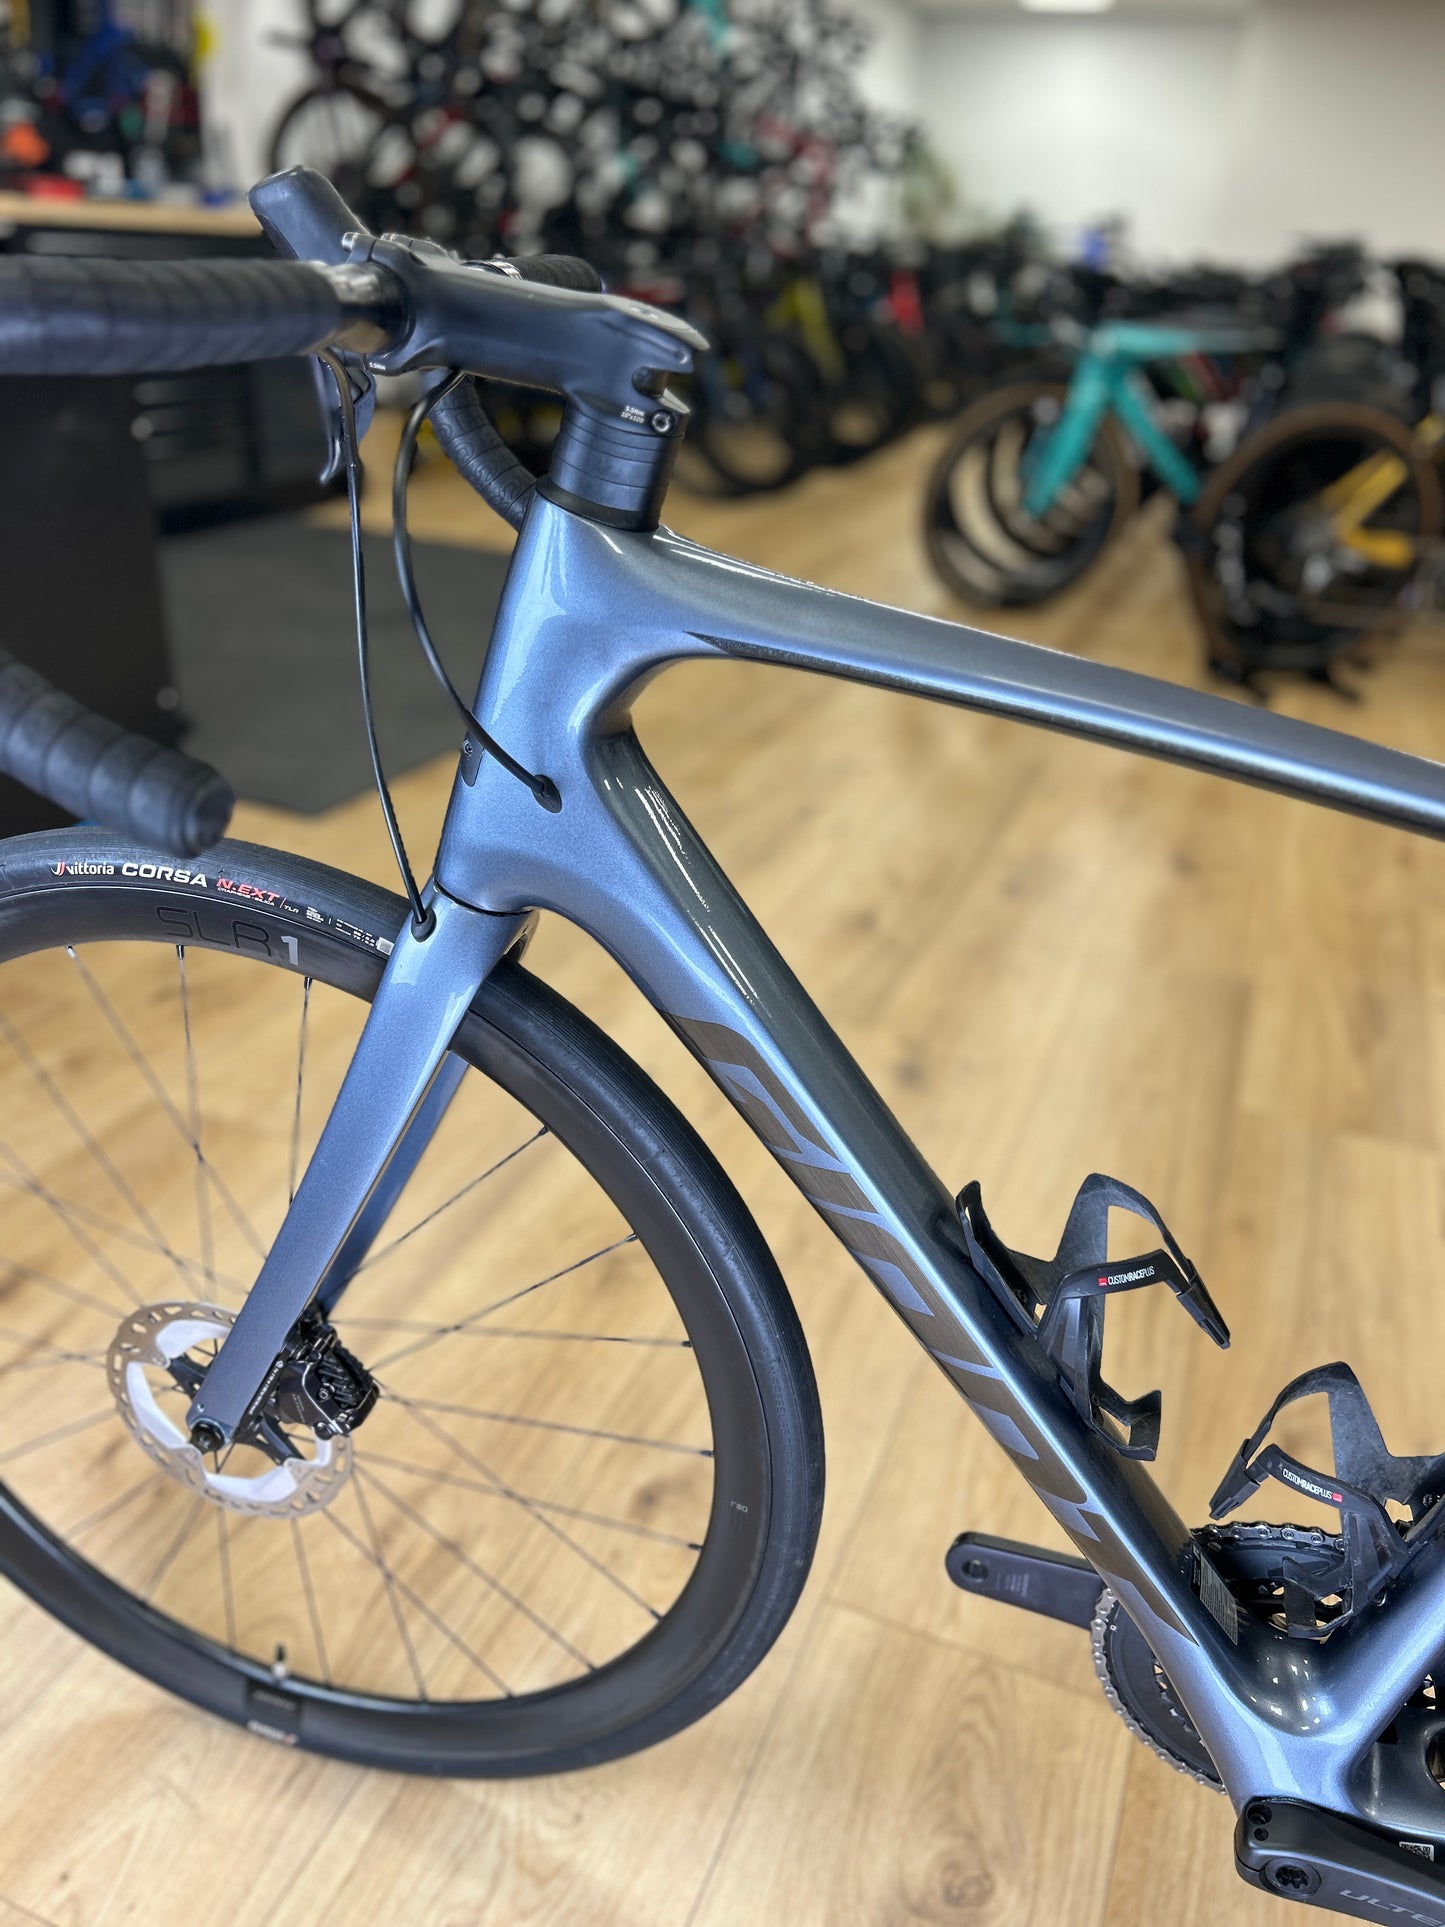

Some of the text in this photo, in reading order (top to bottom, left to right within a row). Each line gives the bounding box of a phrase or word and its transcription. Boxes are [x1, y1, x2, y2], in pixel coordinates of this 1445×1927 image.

[66, 861, 115, 875] vittoria
[121, 862, 208, 888] CORSA
[215, 878, 281, 902] N.EXT
[155, 905, 272, 957] SLR
[280, 935, 299, 966] 1
[660, 1009, 1199, 1647] GIANT
[1339, 1888, 1445, 1927] ULTE
